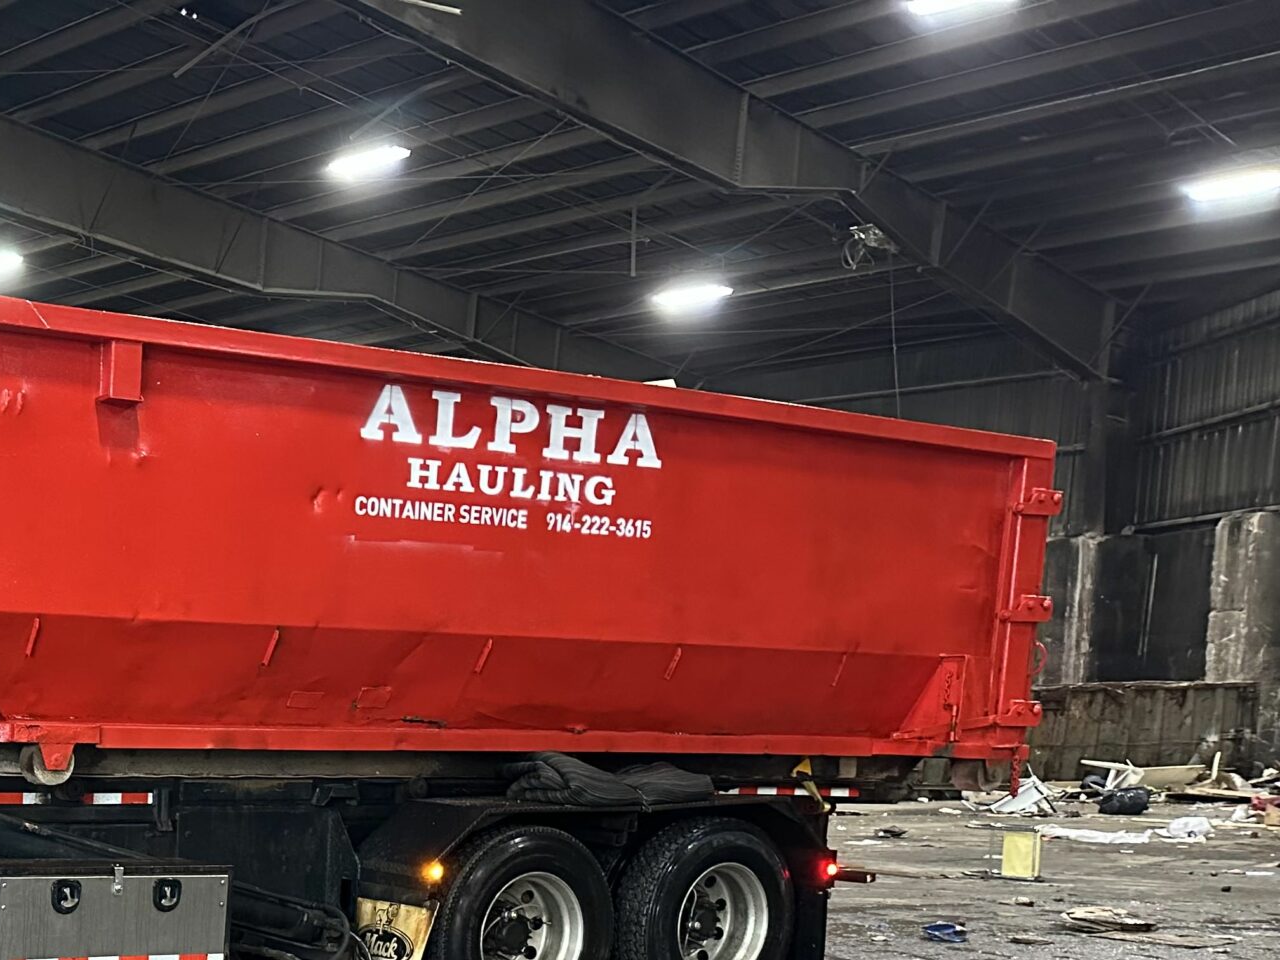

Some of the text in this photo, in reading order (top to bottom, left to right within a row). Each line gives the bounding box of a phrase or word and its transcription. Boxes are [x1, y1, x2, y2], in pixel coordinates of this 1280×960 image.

[360, 384, 662, 469] ALPHA
[406, 457, 616, 506] HAULING
[355, 495, 652, 540] CONTAINER SERVICE 914-222-3615
[365, 932, 398, 960] Mack
